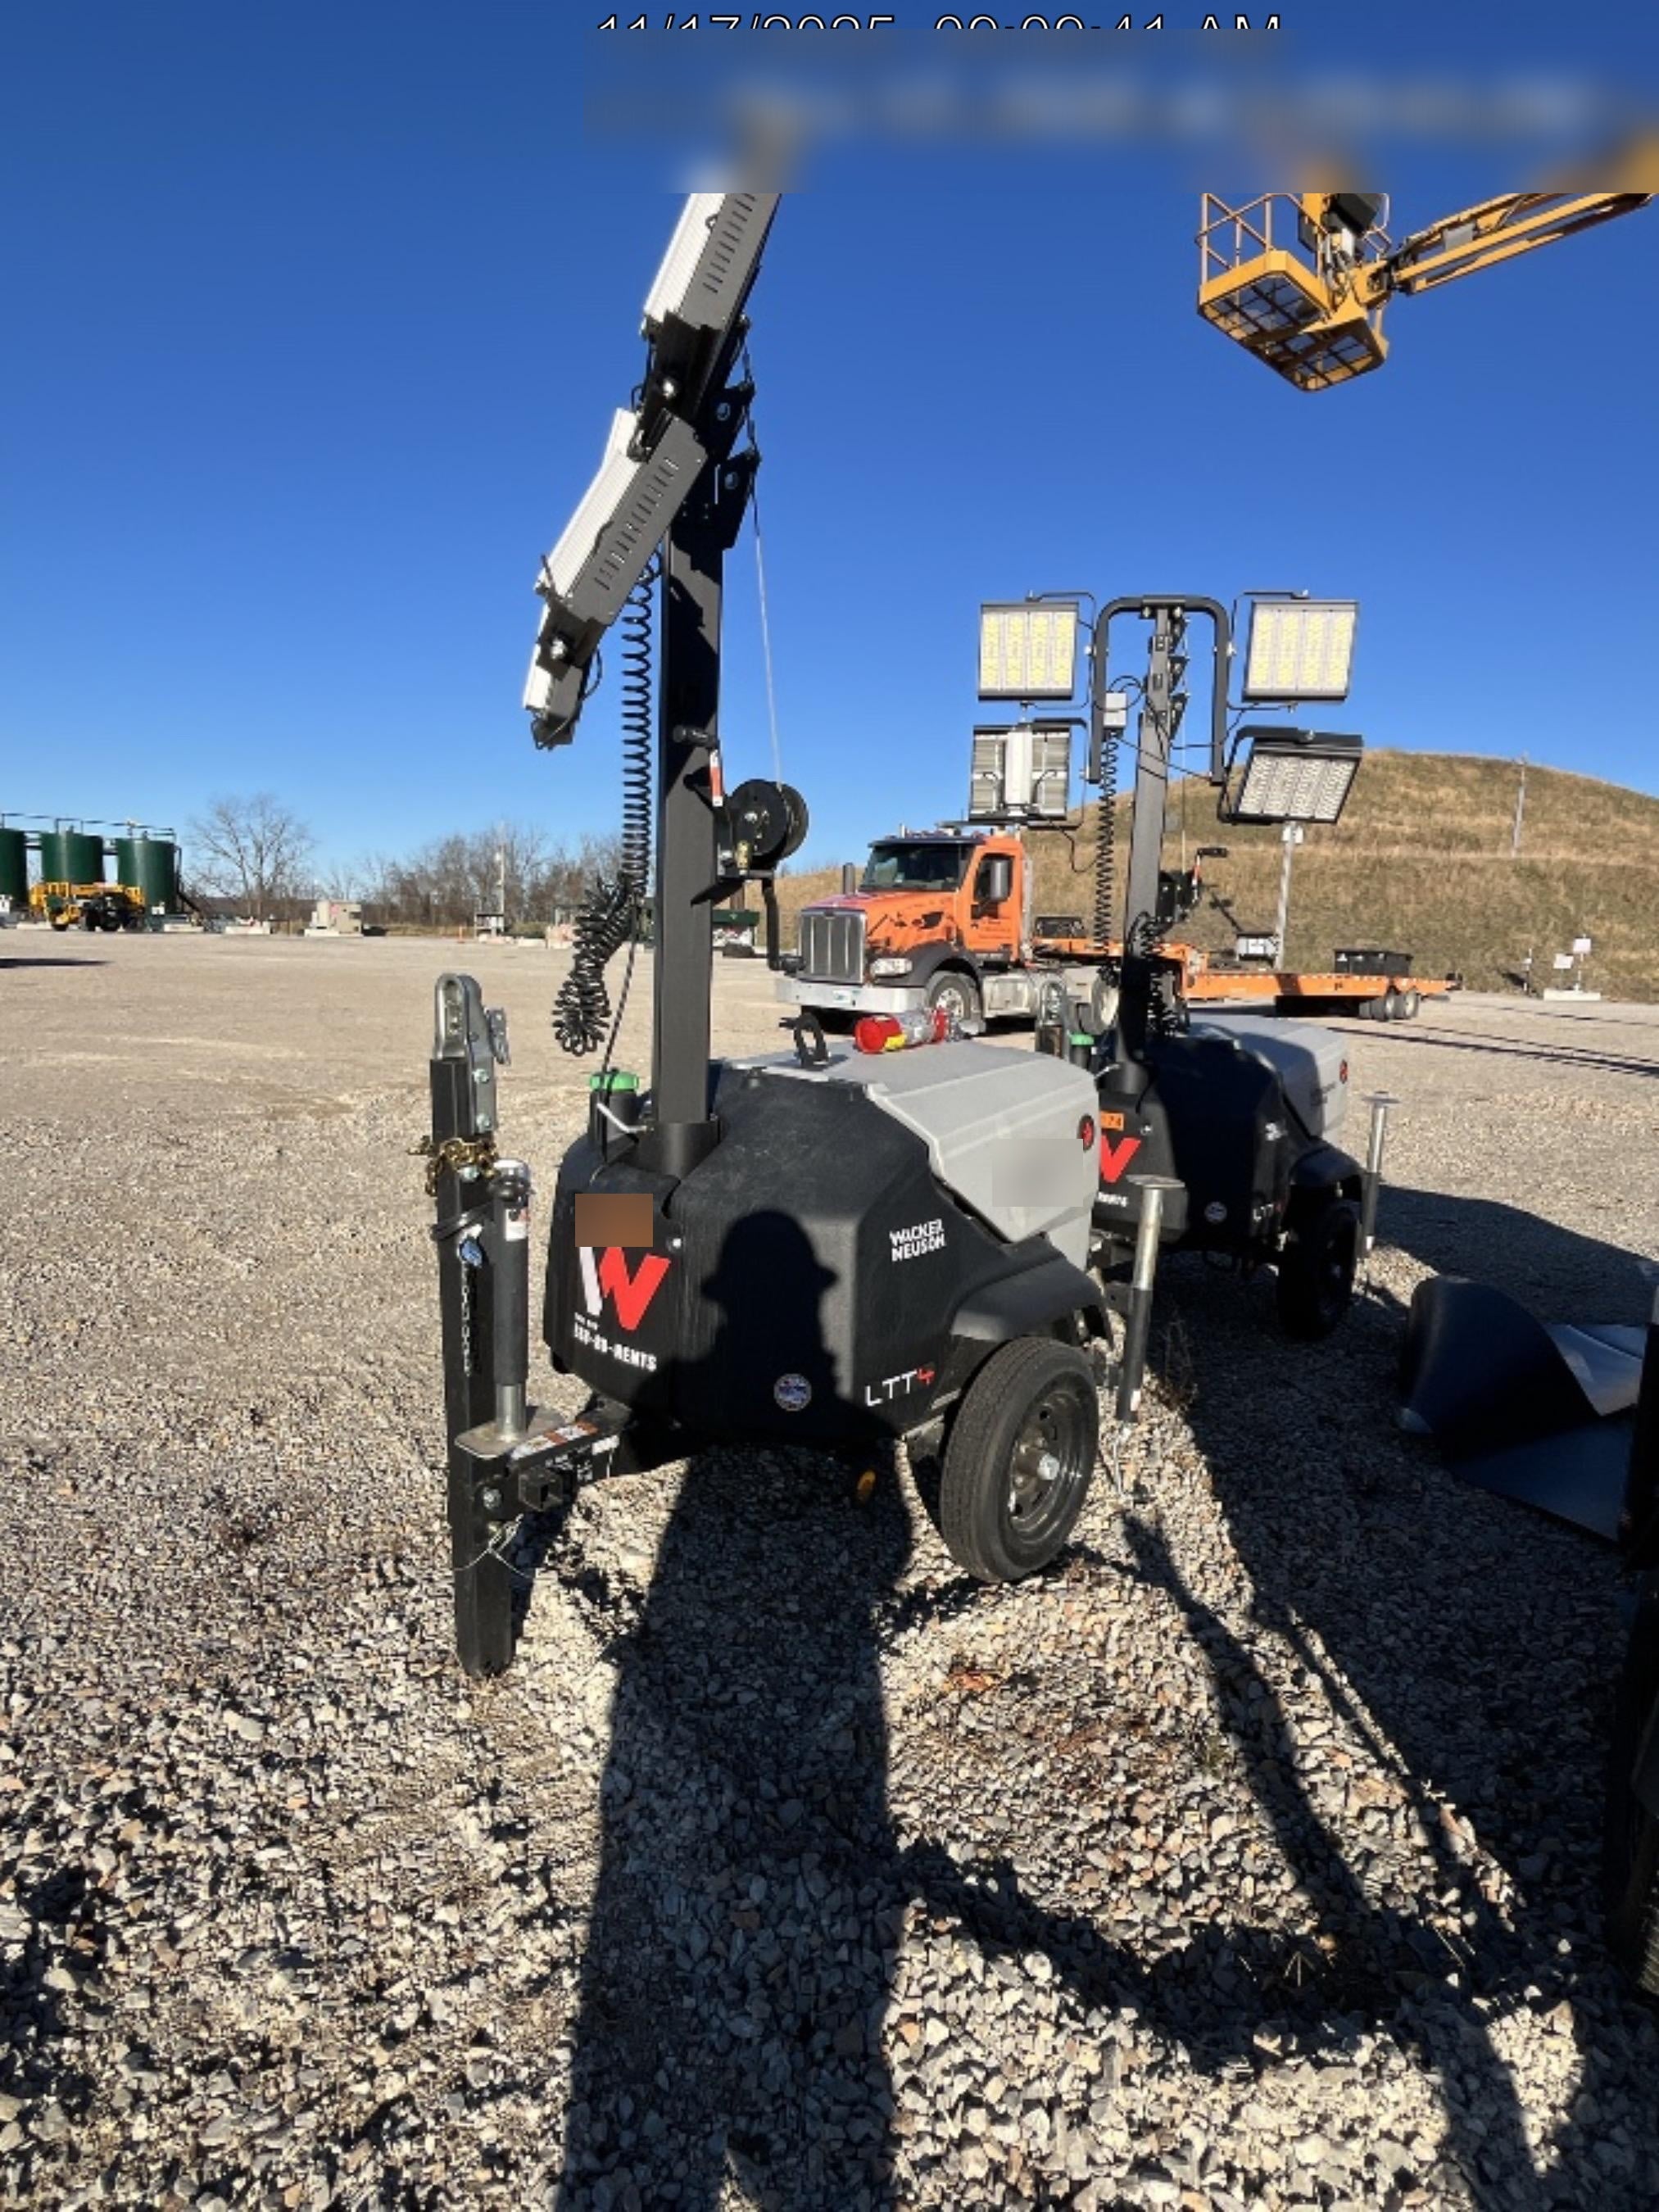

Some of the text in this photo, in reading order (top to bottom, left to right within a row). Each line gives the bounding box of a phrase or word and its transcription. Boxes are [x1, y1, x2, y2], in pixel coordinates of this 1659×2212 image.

[889, 1218, 944, 1246] WACKER
[891, 1233, 946, 1262] NEUSON
[865, 1368, 936, 1407] LTT4
